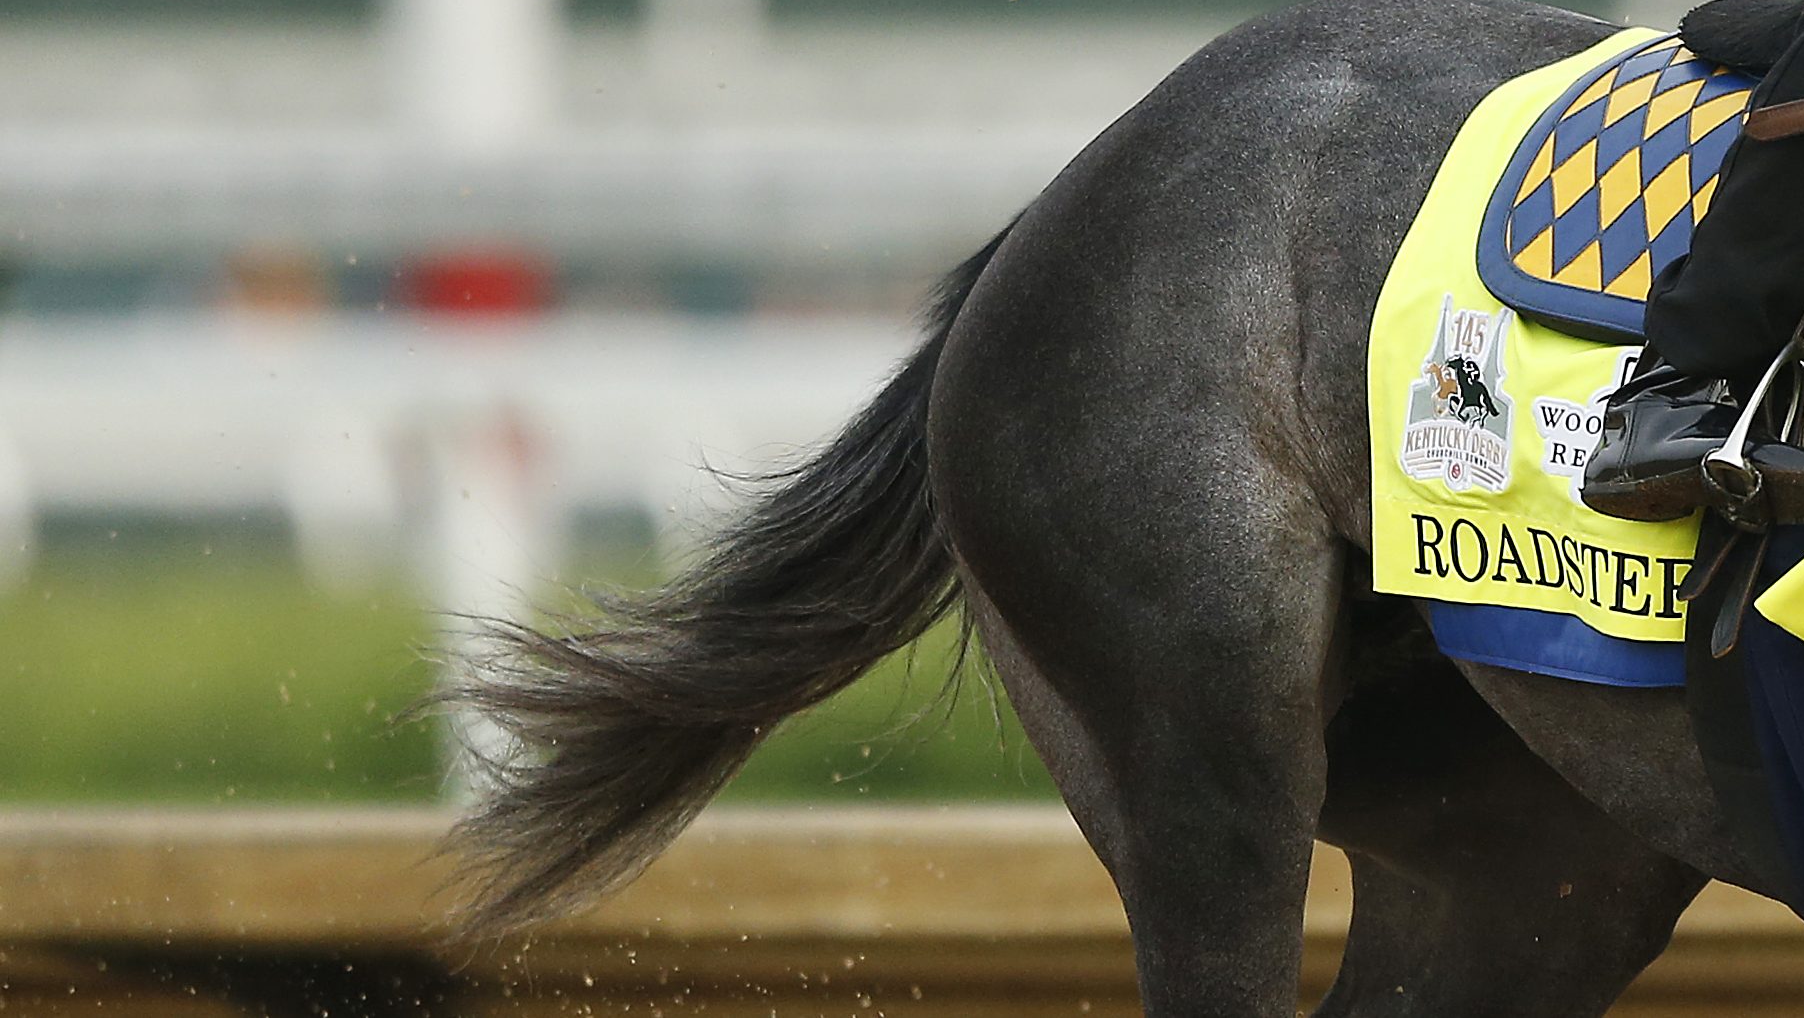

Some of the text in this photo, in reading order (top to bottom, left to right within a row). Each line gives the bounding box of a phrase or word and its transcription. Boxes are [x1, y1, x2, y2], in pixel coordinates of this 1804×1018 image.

[1452, 312, 1489, 357] 145
[1540, 405, 1602, 435] WOO
[1405, 426, 1508, 470] KENTUCKY DERBY
[1550, 442, 1587, 468] RE
